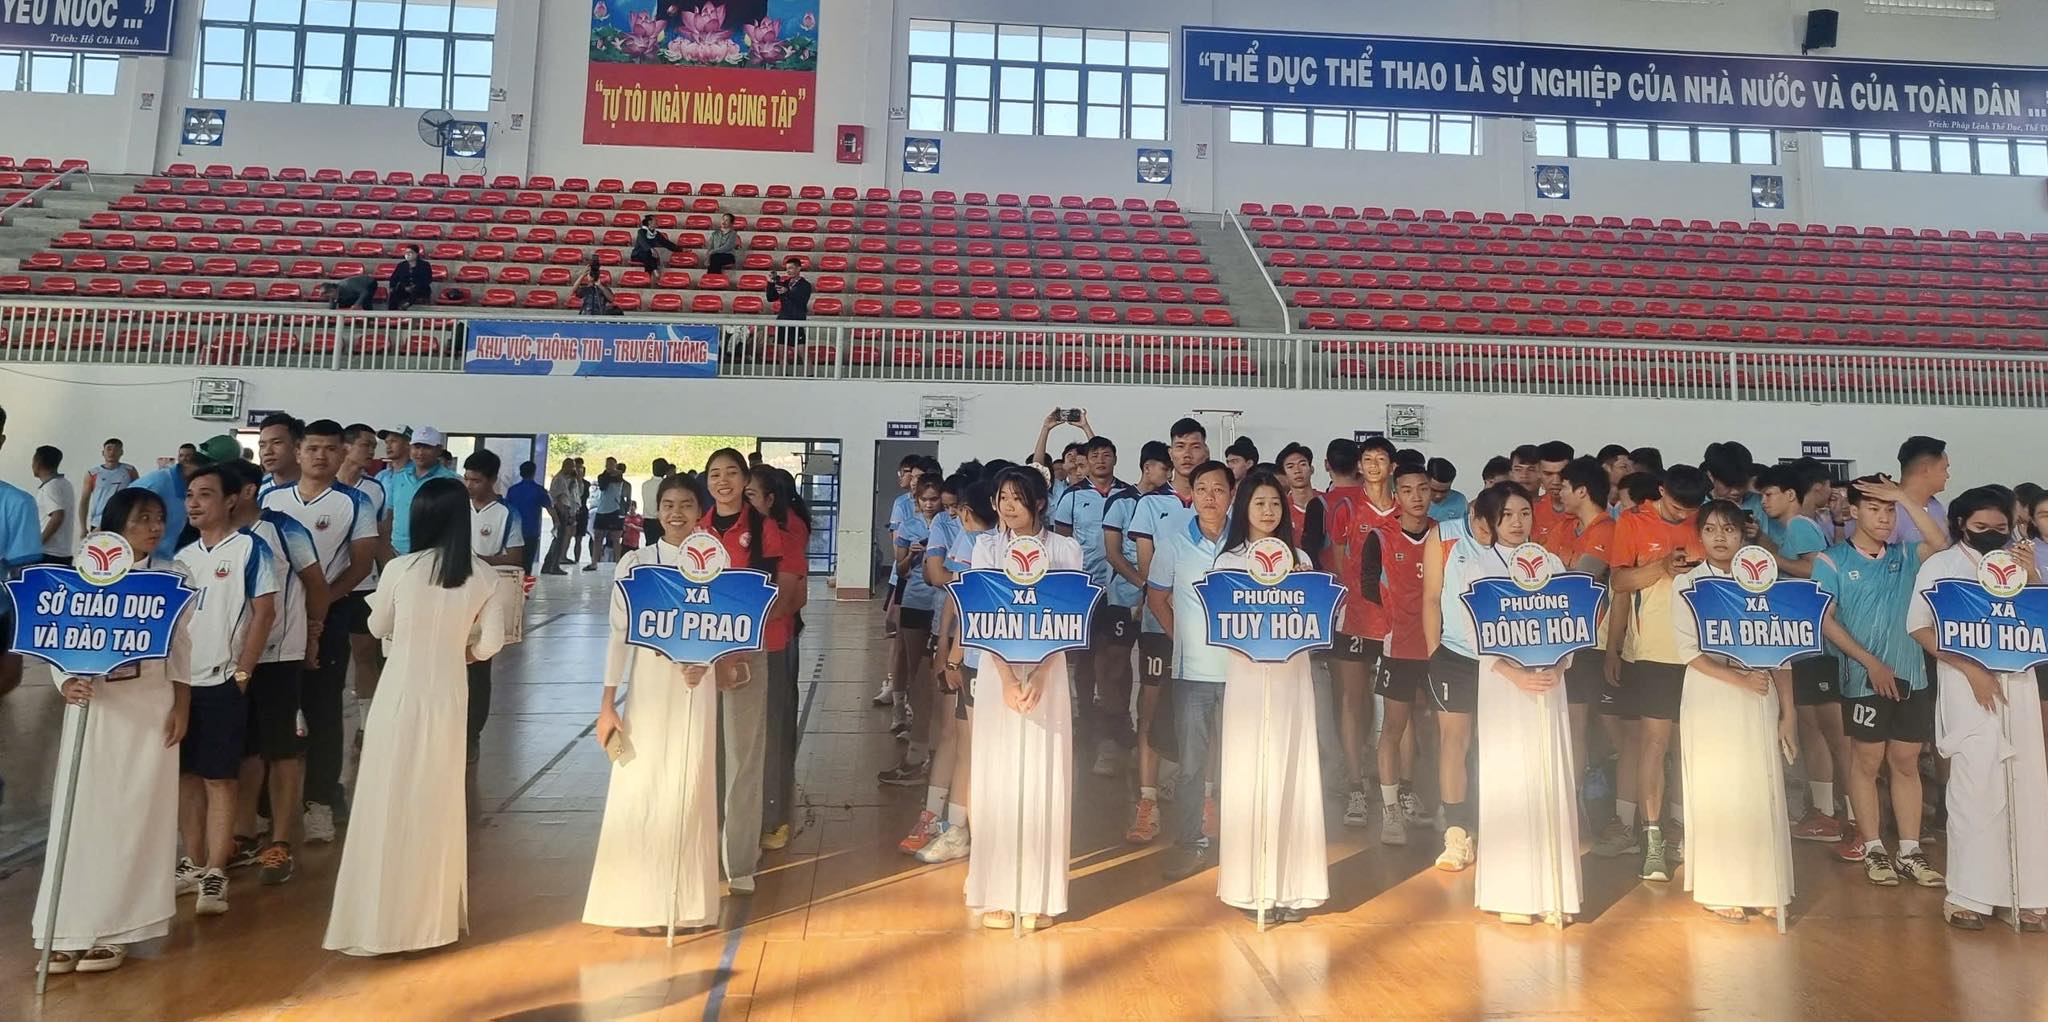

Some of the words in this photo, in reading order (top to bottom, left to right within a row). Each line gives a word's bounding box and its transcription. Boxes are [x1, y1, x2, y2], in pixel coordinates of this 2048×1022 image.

[50, 33, 78, 43] Trích:
[96, 35, 113, 44] Chí
[115, 36, 139, 45] Minh
[1199, 40, 1259, 83] “THỂ
[1267, 56, 1317, 93] DỤC
[1324, 44, 1373, 88] THỂ
[1381, 60, 1447, 92] THAO
[1455, 56, 1485, 93] LÀ
[1492, 61, 1525, 102] SỰ
[1531, 64, 1621, 107] NGHIỆP
[1628, 63, 1677, 103] CỦA
[1684, 69, 1734, 105] NHÀ
[1741, 72, 1806, 108] NƯỚC
[1812, 74, 1845, 109] VÀ
[1851, 72, 1899, 112] CỦA
[1904, 78, 1967, 115] TOÀN
[1973, 82, 2021, 116] DÂN
[595, 80, 622, 128] “TỰ
[624, 83, 647, 122] TÔI
[650, 84, 690, 124] NGÀY
[693, 85, 723, 125] NÀO
[727, 88, 766, 127] CŨNG
[771, 88, 806, 135] TẬP”
[476, 336, 505, 360] KHU
[505, 335, 532, 365] VỰC
[535, 333, 577, 361] THÔNG
[582, 338, 604, 362] TIN
[666, 336, 708, 364] THÔNG
[36, 584, 67, 616] SỞ
[70, 588, 117, 617] GIÁO
[122, 594, 166, 624] DỤC
[684, 586, 711, 604] XÃ
[1012, 587, 1038, 605] XÃ
[1233, 587, 1305, 605] PHƯỜNG
[1500, 593, 1569, 612] PHƯỜNG
[1745, 595, 1770, 612] XÃ
[1991, 601, 2017, 618] XÃ
[33, 622, 59, 648] VÀ
[64, 623, 106, 650] ĐÀO
[112, 629, 151, 656] TẠO
[638, 608, 680, 639] CƯ
[681, 612, 752, 643] PRAO
[966, 608, 1023, 640] XUÂN
[1029, 608, 1083, 641] LÃNH
[1217, 612, 1263, 640] TUY
[1270, 607, 1321, 640] HÒA
[1481, 615, 1541, 648] ĐÔNG
[1547, 610, 1591, 644] HÒA
[1705, 619, 1735, 646] EA
[1739, 614, 1814, 647] ĐRĂNG
[1944, 618, 1991, 649] PHÚ
[1998, 619, 2048, 654] HÒA
[1147, 656, 1162, 676] 10
[1383, 670, 1391, 688] 3
[1853, 703, 1876, 728] 02
